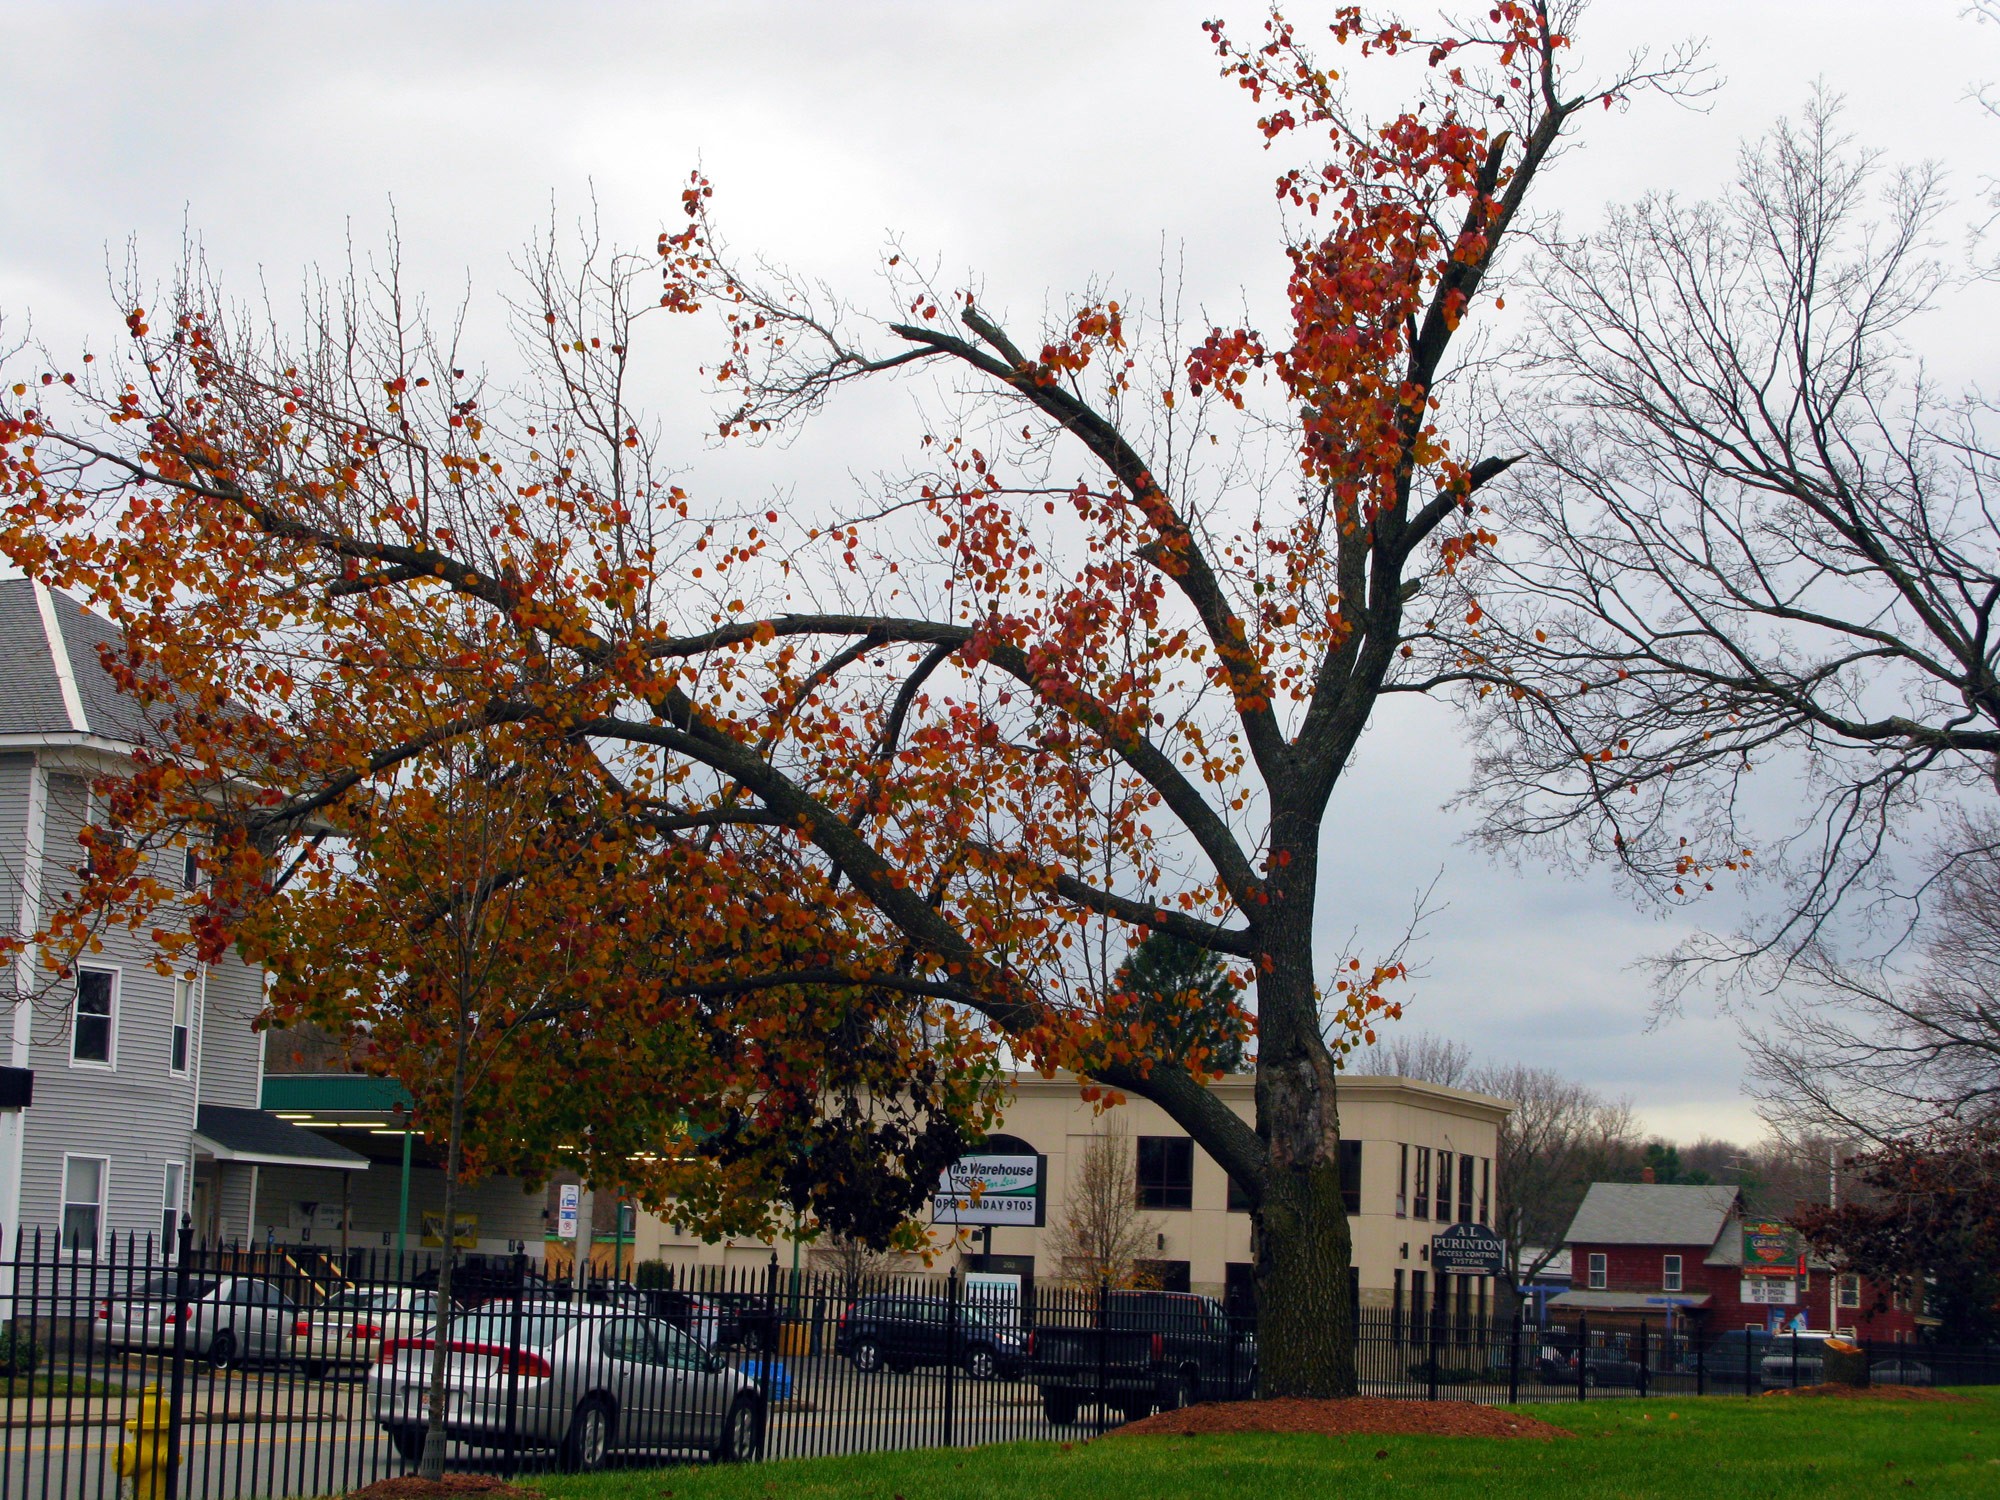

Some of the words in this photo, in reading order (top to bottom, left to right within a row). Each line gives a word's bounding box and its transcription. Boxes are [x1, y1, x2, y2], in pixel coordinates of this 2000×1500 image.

[951, 1163, 968, 1175] ire
[970, 1163, 1034, 1176] Warehouse
[1001, 1176, 1018, 1187] Less
[1457, 1226, 1466, 1236] A
[1469, 1226, 1478, 1237] L
[1433, 1238, 1502, 1251] PURINTON
[1465, 1251, 1499, 1259] CONTROL
